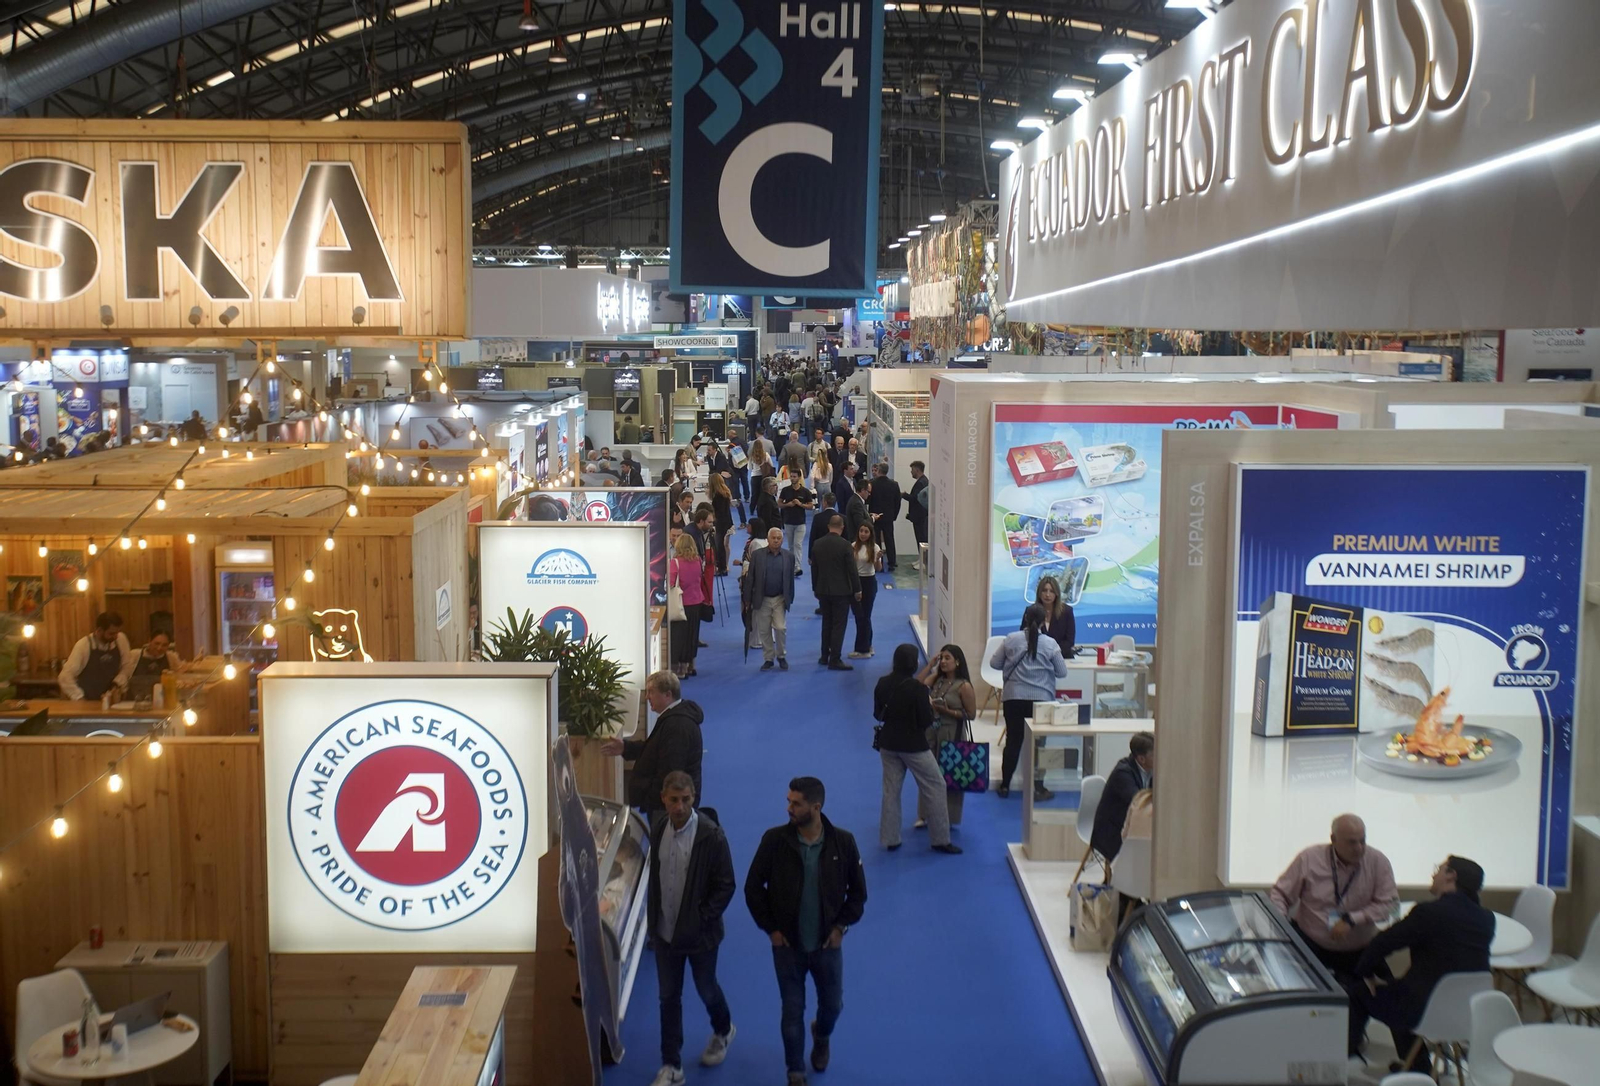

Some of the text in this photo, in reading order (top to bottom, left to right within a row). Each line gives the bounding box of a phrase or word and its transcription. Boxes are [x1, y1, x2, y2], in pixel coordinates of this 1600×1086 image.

[779, 2, 860, 39] Hall
[821, 47, 858, 98] 4
[1027, 0, 1476, 243] ECUADOR FIRST CLASS
[718, 121, 833, 277] C
[0, 158, 404, 303] SKA
[657, 338, 717, 346] SHOWCOOKING
[1547, 338, 1585, 346] Canada
[967, 411, 978, 486] PROMAROSA
[1188, 481, 1206, 566] EXPALSA
[1333, 534, 1500, 553] PREMIUM WHITE
[1318, 562, 1512, 580] VANNAMEI SHRIMP
[1308, 614, 1348, 627] WONDER
[1510, 623, 1545, 638] FROM
[1497, 674, 1552, 686] ECUADOR
[304, 715, 513, 821] AMERICAN SEAFOODS
[312, 843, 509, 916] PRIDE OF THE SEA
